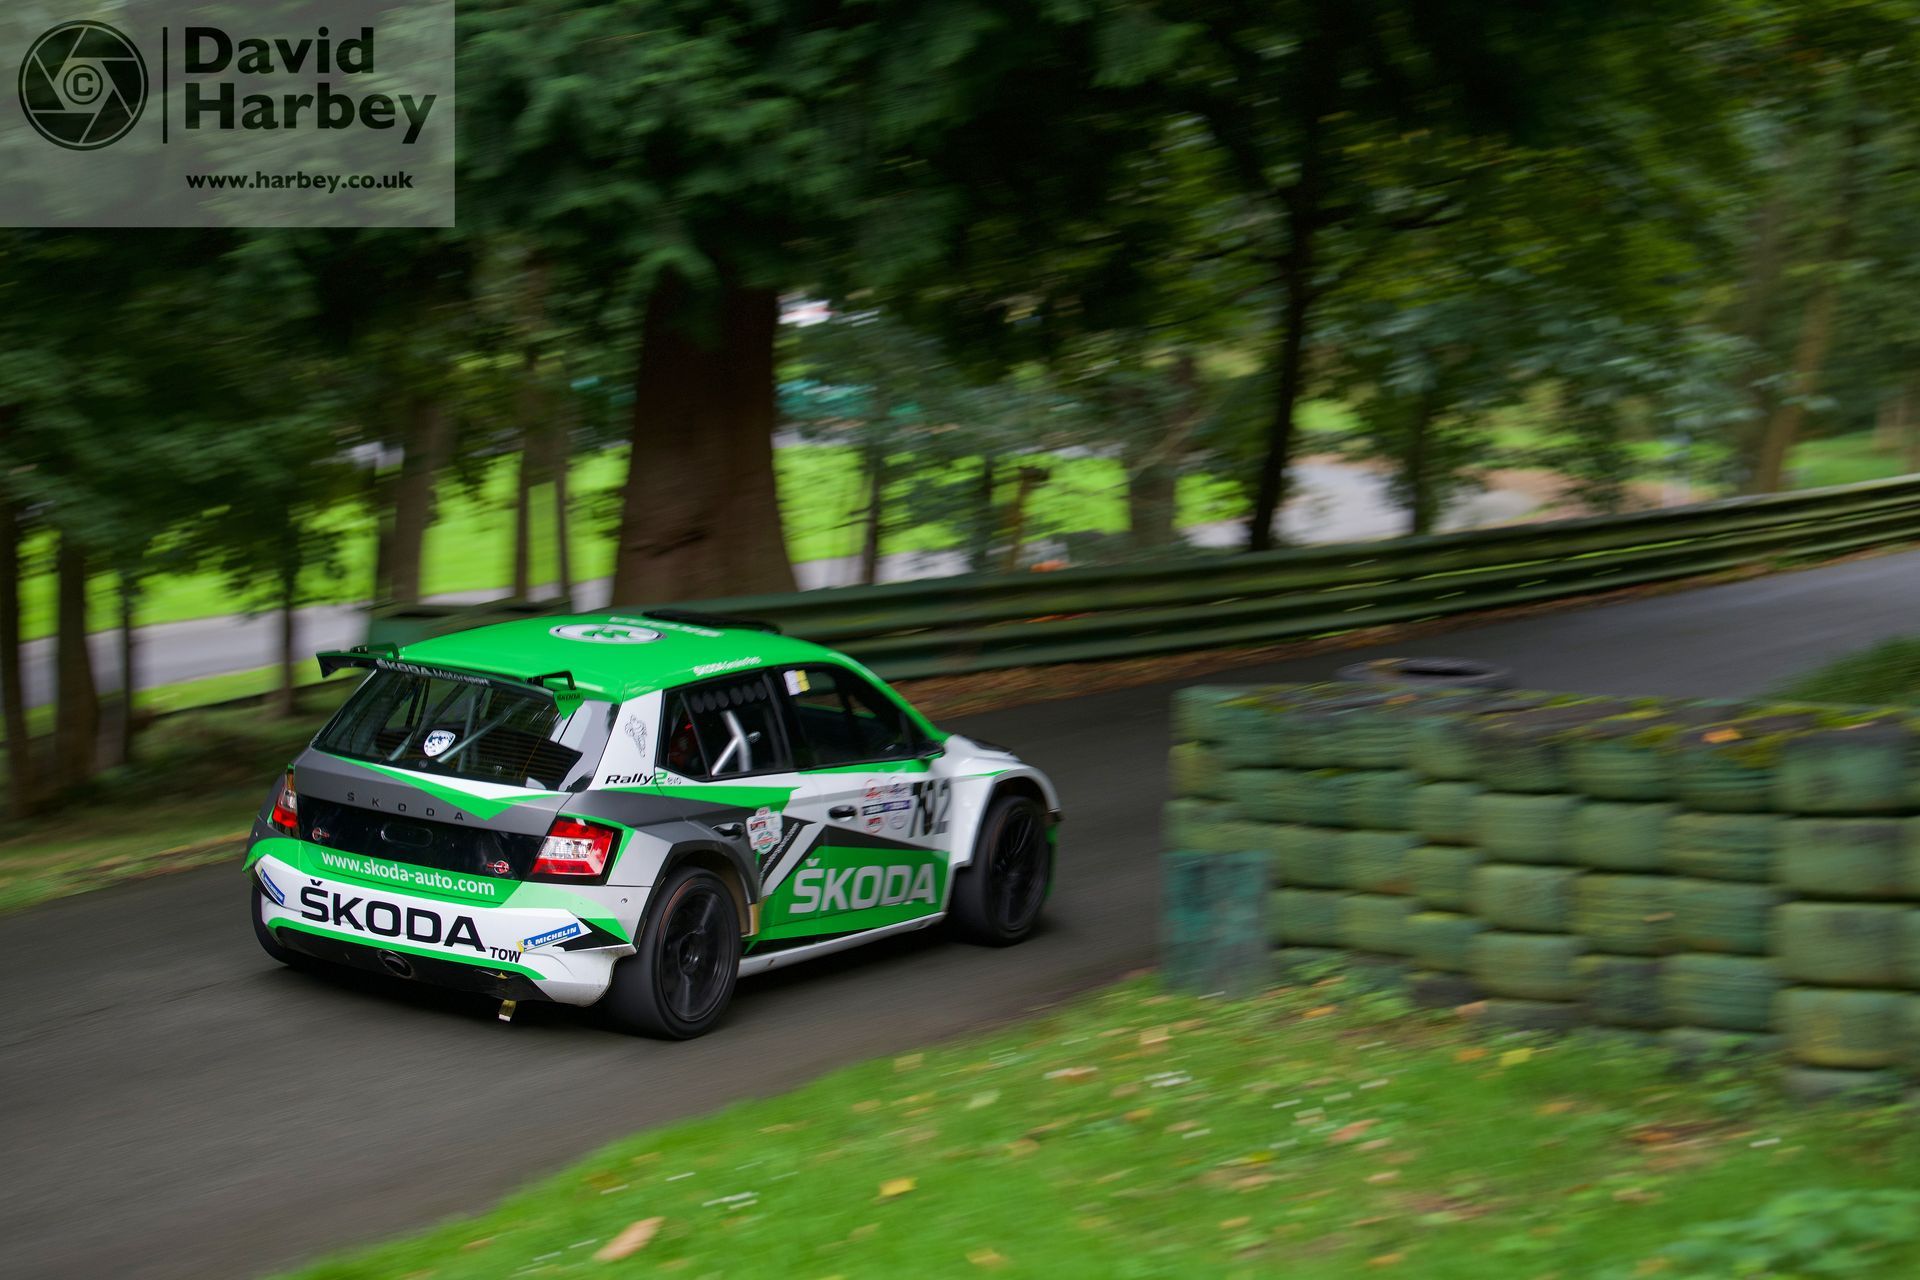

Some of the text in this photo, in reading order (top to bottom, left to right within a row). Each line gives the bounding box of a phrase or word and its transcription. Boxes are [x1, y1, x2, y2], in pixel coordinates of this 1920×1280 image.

[320, 850, 495, 896] www.skoda-auto.com
[788, 857, 937, 914] ŠKODA
[300, 879, 487, 952] ŠKODA
[535, 926, 577, 945] MICHELIN
[489, 946, 522, 963] TOW
